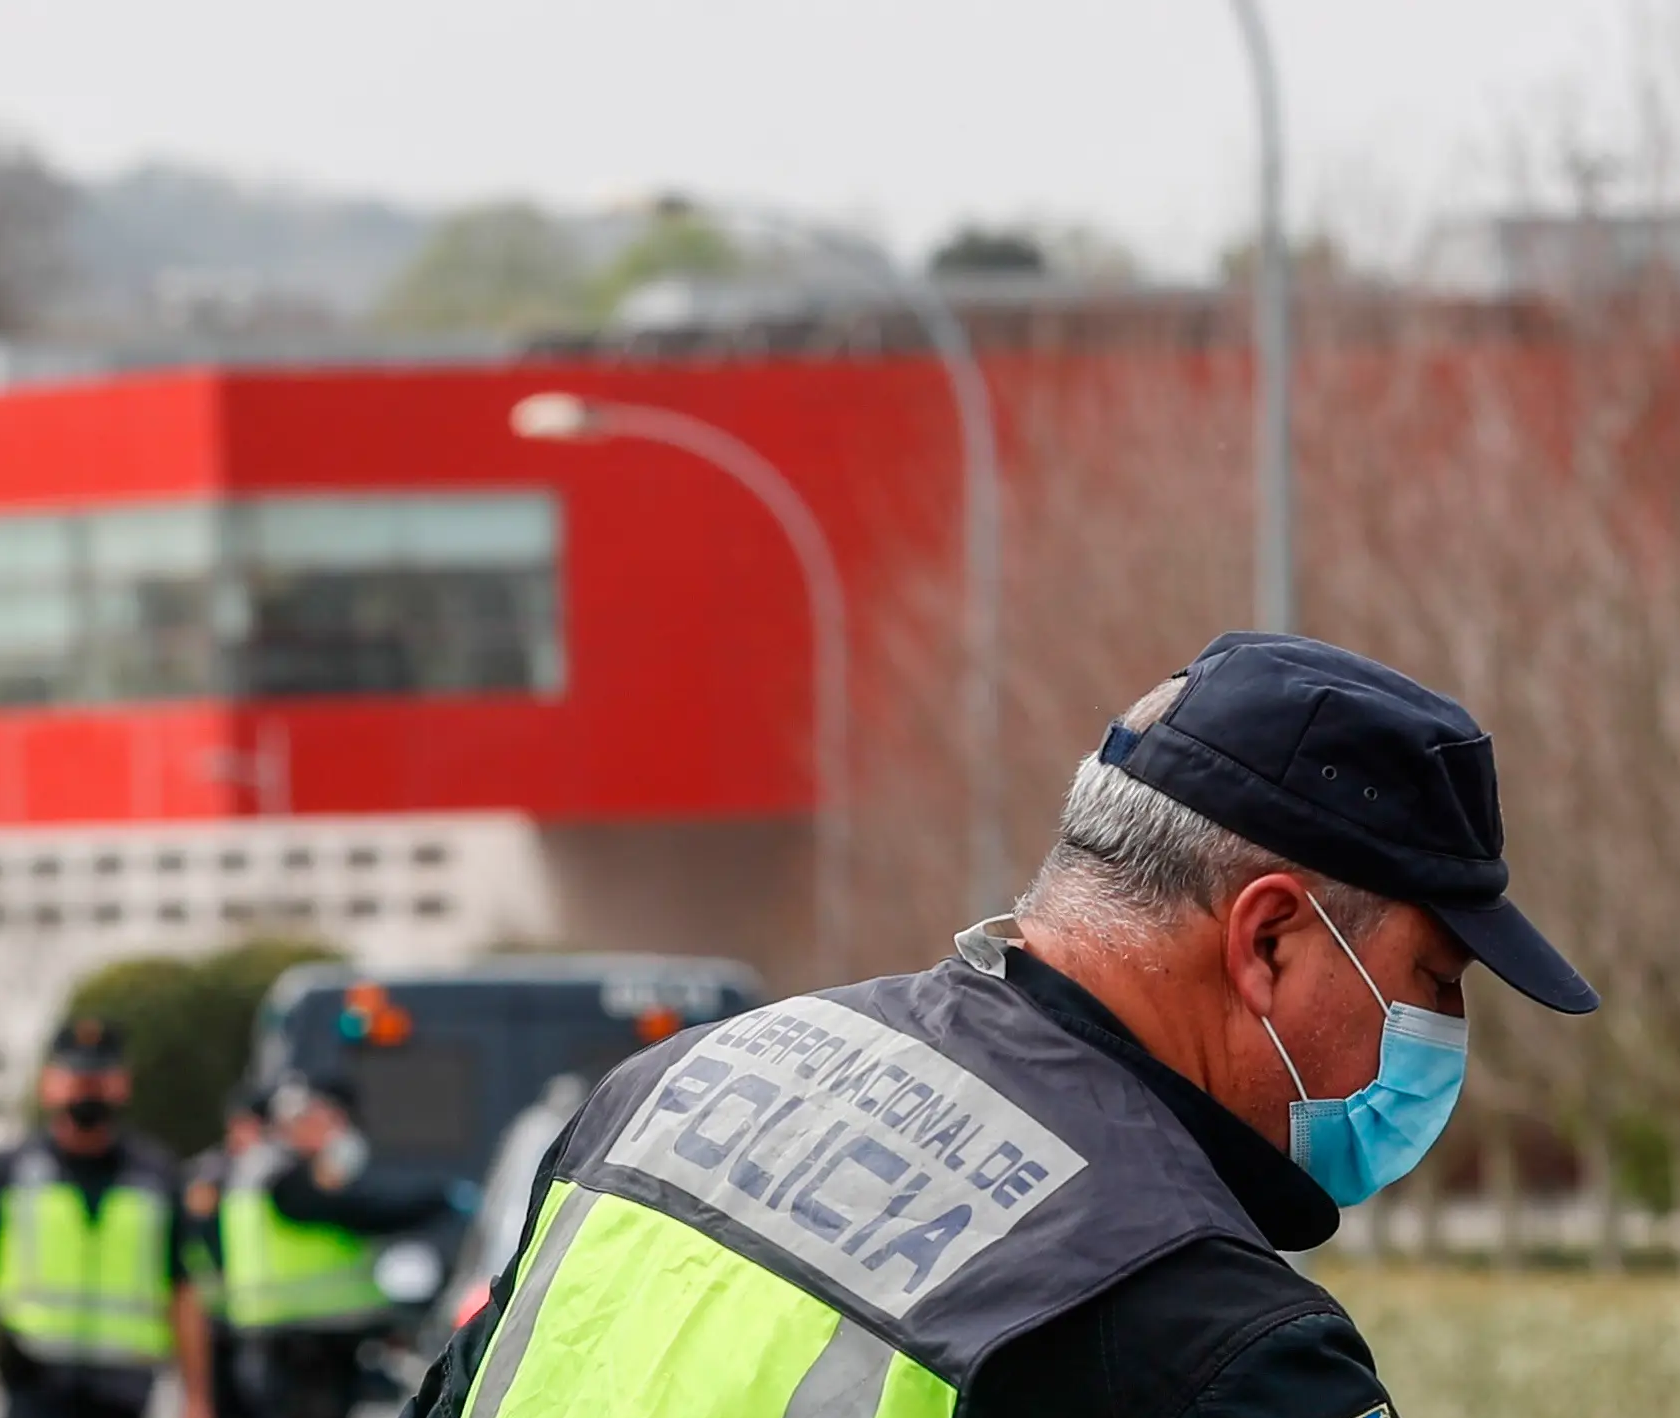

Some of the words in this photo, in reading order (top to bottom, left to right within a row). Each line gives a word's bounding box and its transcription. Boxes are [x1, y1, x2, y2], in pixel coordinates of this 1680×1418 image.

[630, 1055, 973, 1295] POLICIA
[715, 1010, 845, 1080] CUERPO
[817, 1047, 984, 1172] NACIONAL
[965, 1140, 1050, 1210] DE
